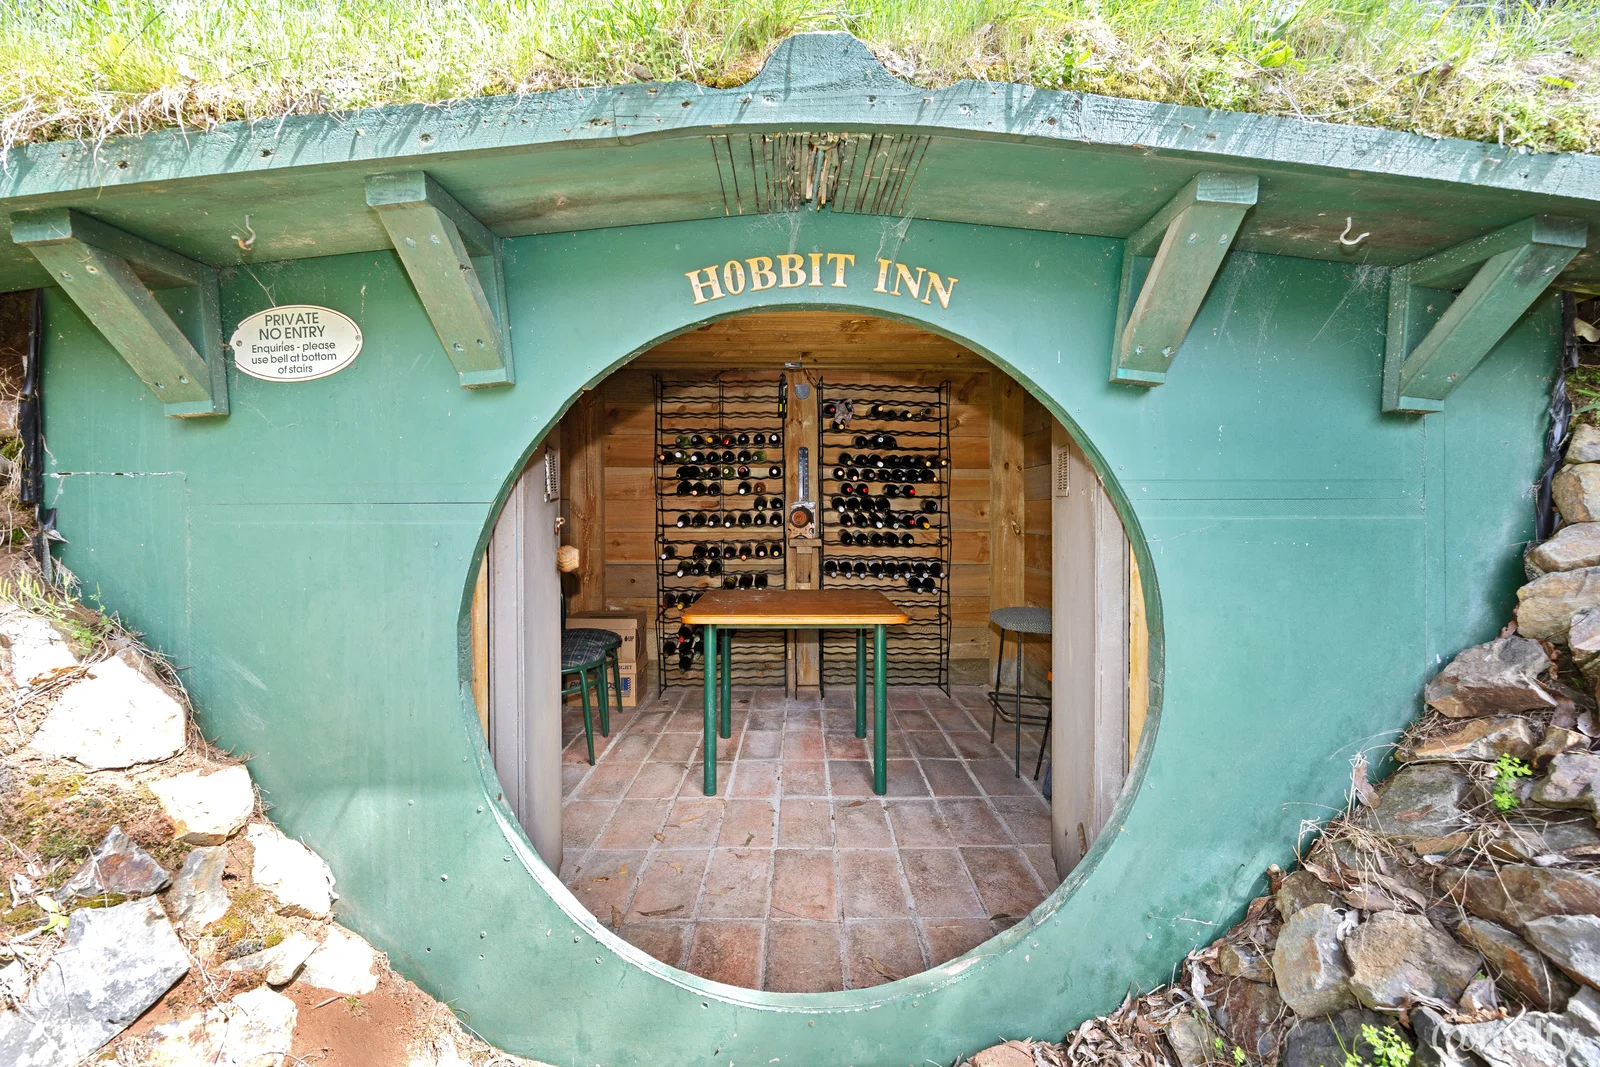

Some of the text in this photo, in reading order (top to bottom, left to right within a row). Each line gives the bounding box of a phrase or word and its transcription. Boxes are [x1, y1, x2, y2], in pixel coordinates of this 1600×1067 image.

[685, 252, 959, 309] HOBBIT INN
[264, 312, 319, 326] PRIVATE
[259, 325, 325, 341] NO ENTRY
[252, 342, 295, 355] Enquiries
[302, 342, 336, 354] please
[251, 352, 337, 365] use bell at bottom
[278, 364, 313, 374] of stairs
